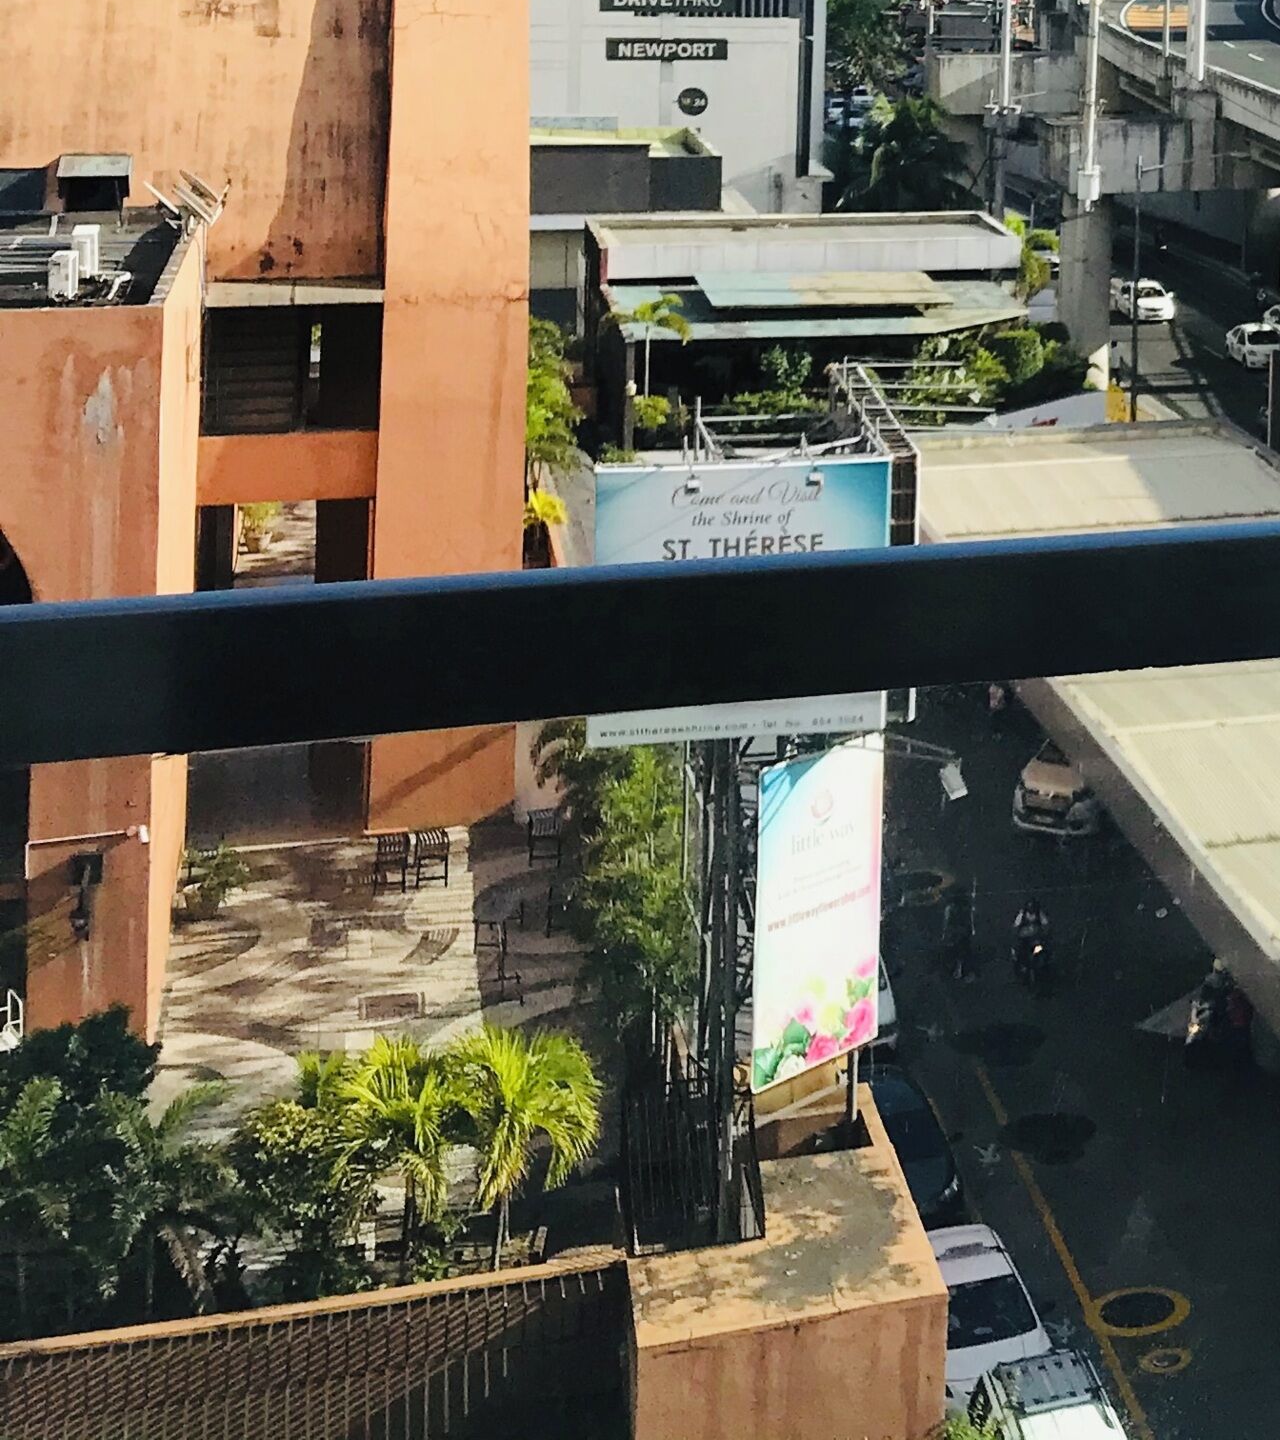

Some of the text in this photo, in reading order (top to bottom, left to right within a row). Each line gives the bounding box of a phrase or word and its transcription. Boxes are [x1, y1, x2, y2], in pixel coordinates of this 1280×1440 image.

[618, 42, 717, 58] NEWPORT
[730, 486, 765, 505] and
[768, 480, 823, 505] Visit
[692, 510, 793, 527] the Shrine of
